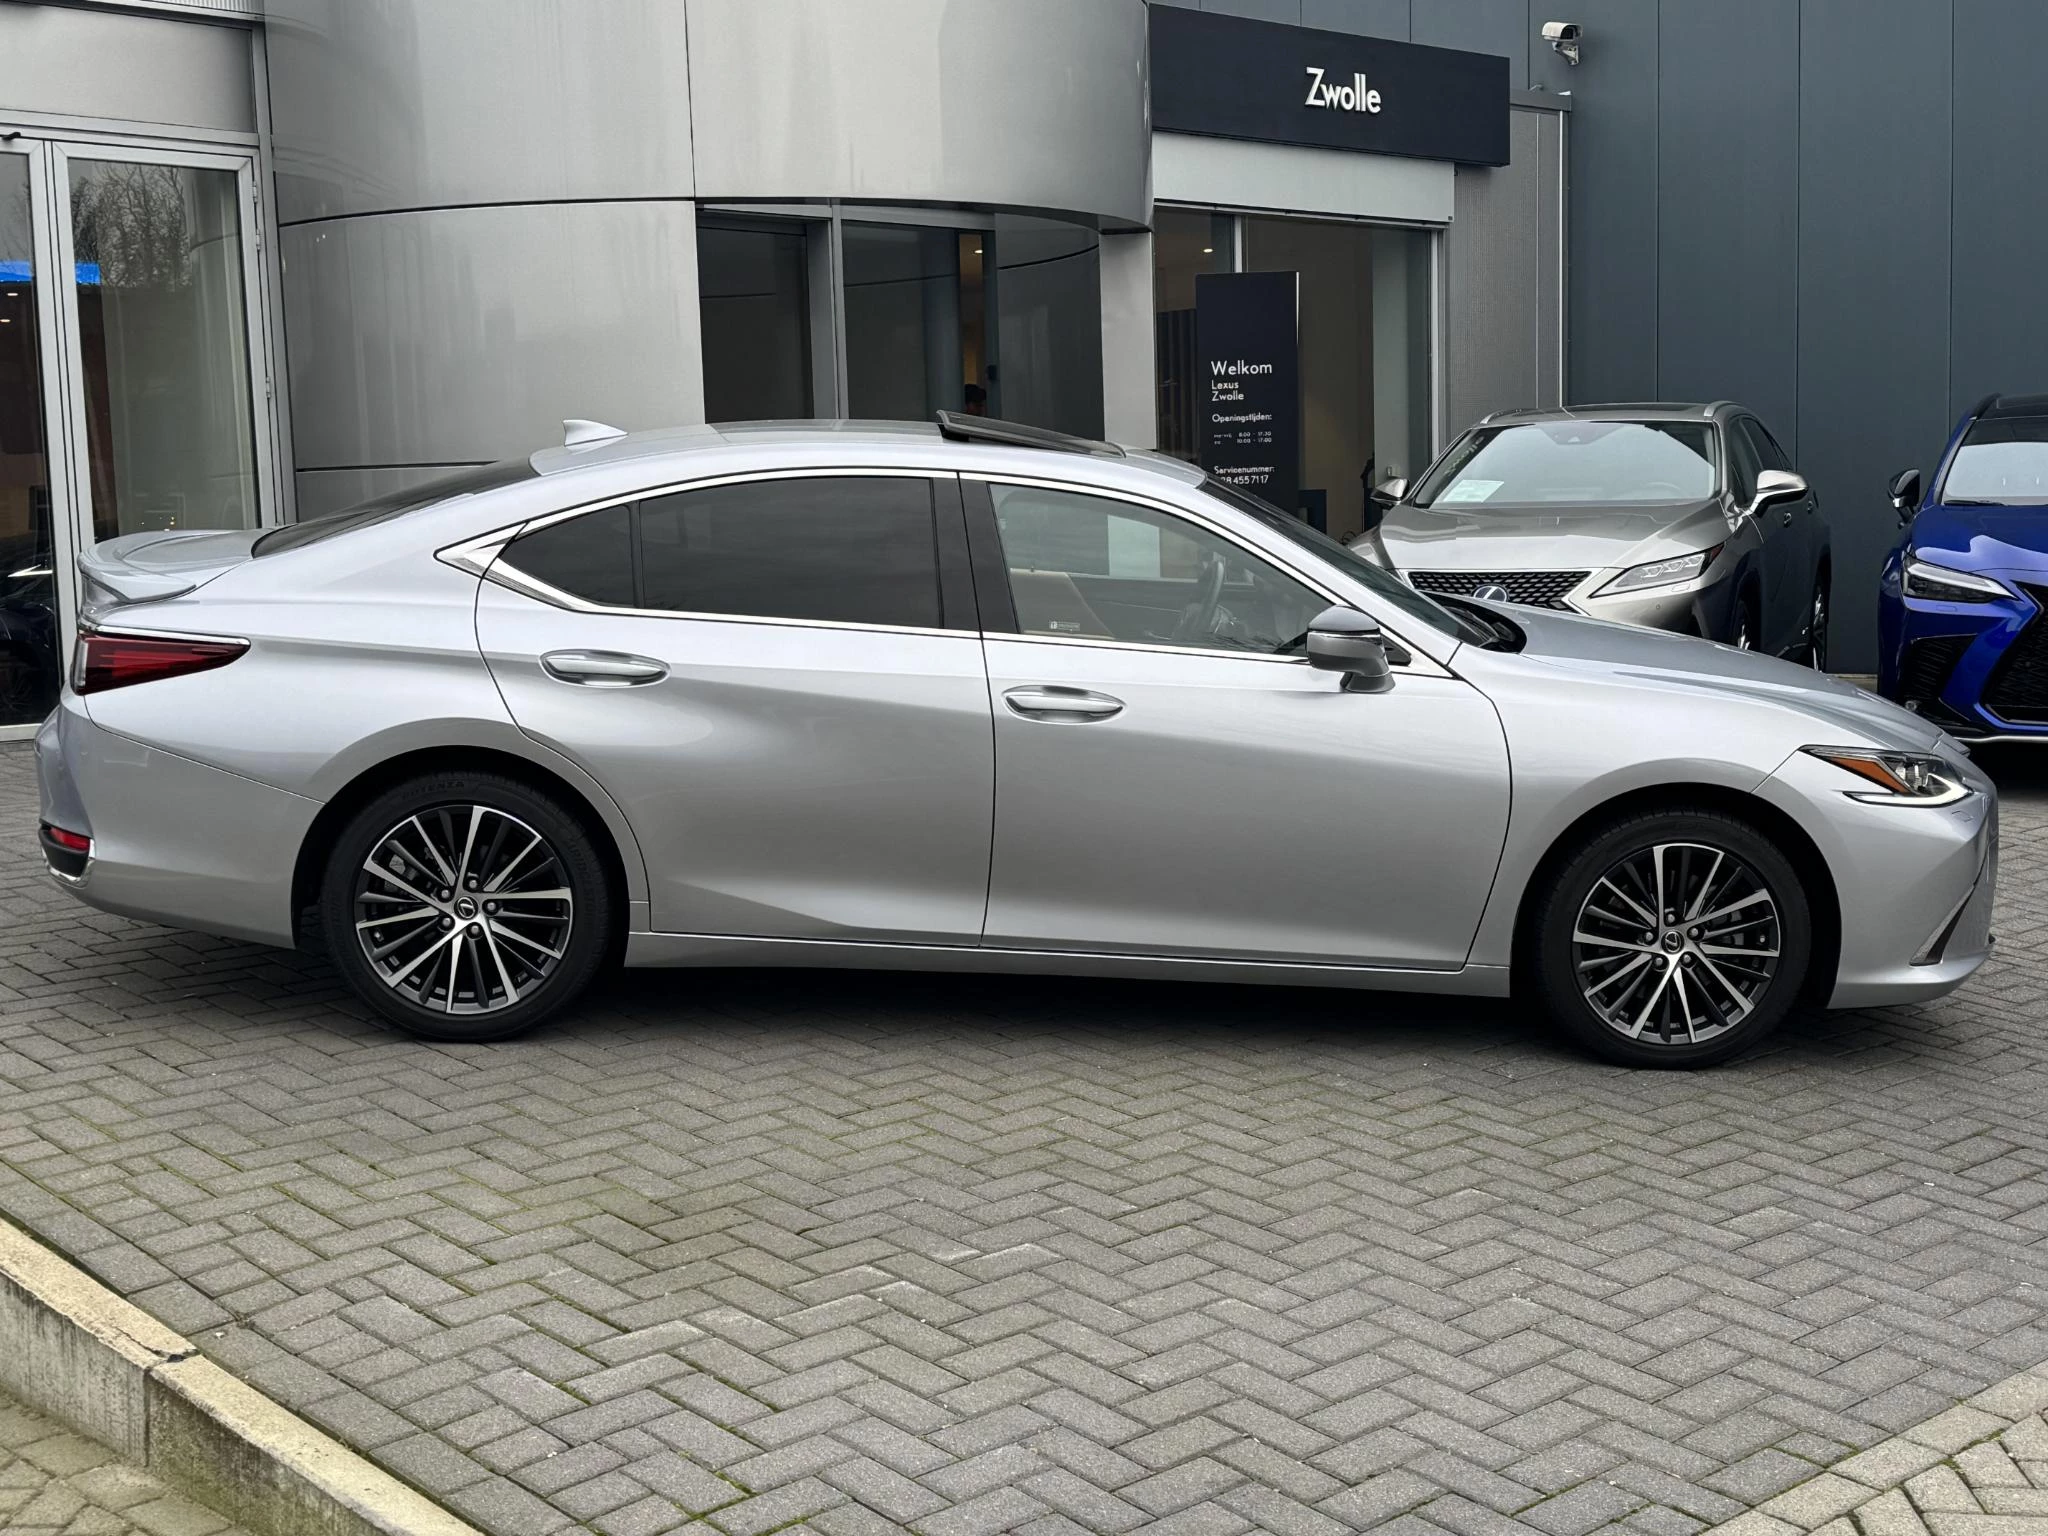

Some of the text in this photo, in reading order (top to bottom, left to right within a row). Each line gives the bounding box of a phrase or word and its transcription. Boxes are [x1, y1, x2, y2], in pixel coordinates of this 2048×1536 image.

[1305, 66, 1382, 114] Zwolle
[1211, 360, 1272, 375] Welkom
[1211, 379, 1239, 390] Lexus
[1211, 390, 1245, 401] Zwolle
[1211, 412, 1272, 423] Openingstijden:
[1233, 475, 1250, 485] 455
[1250, 474, 1269, 484] 7117
